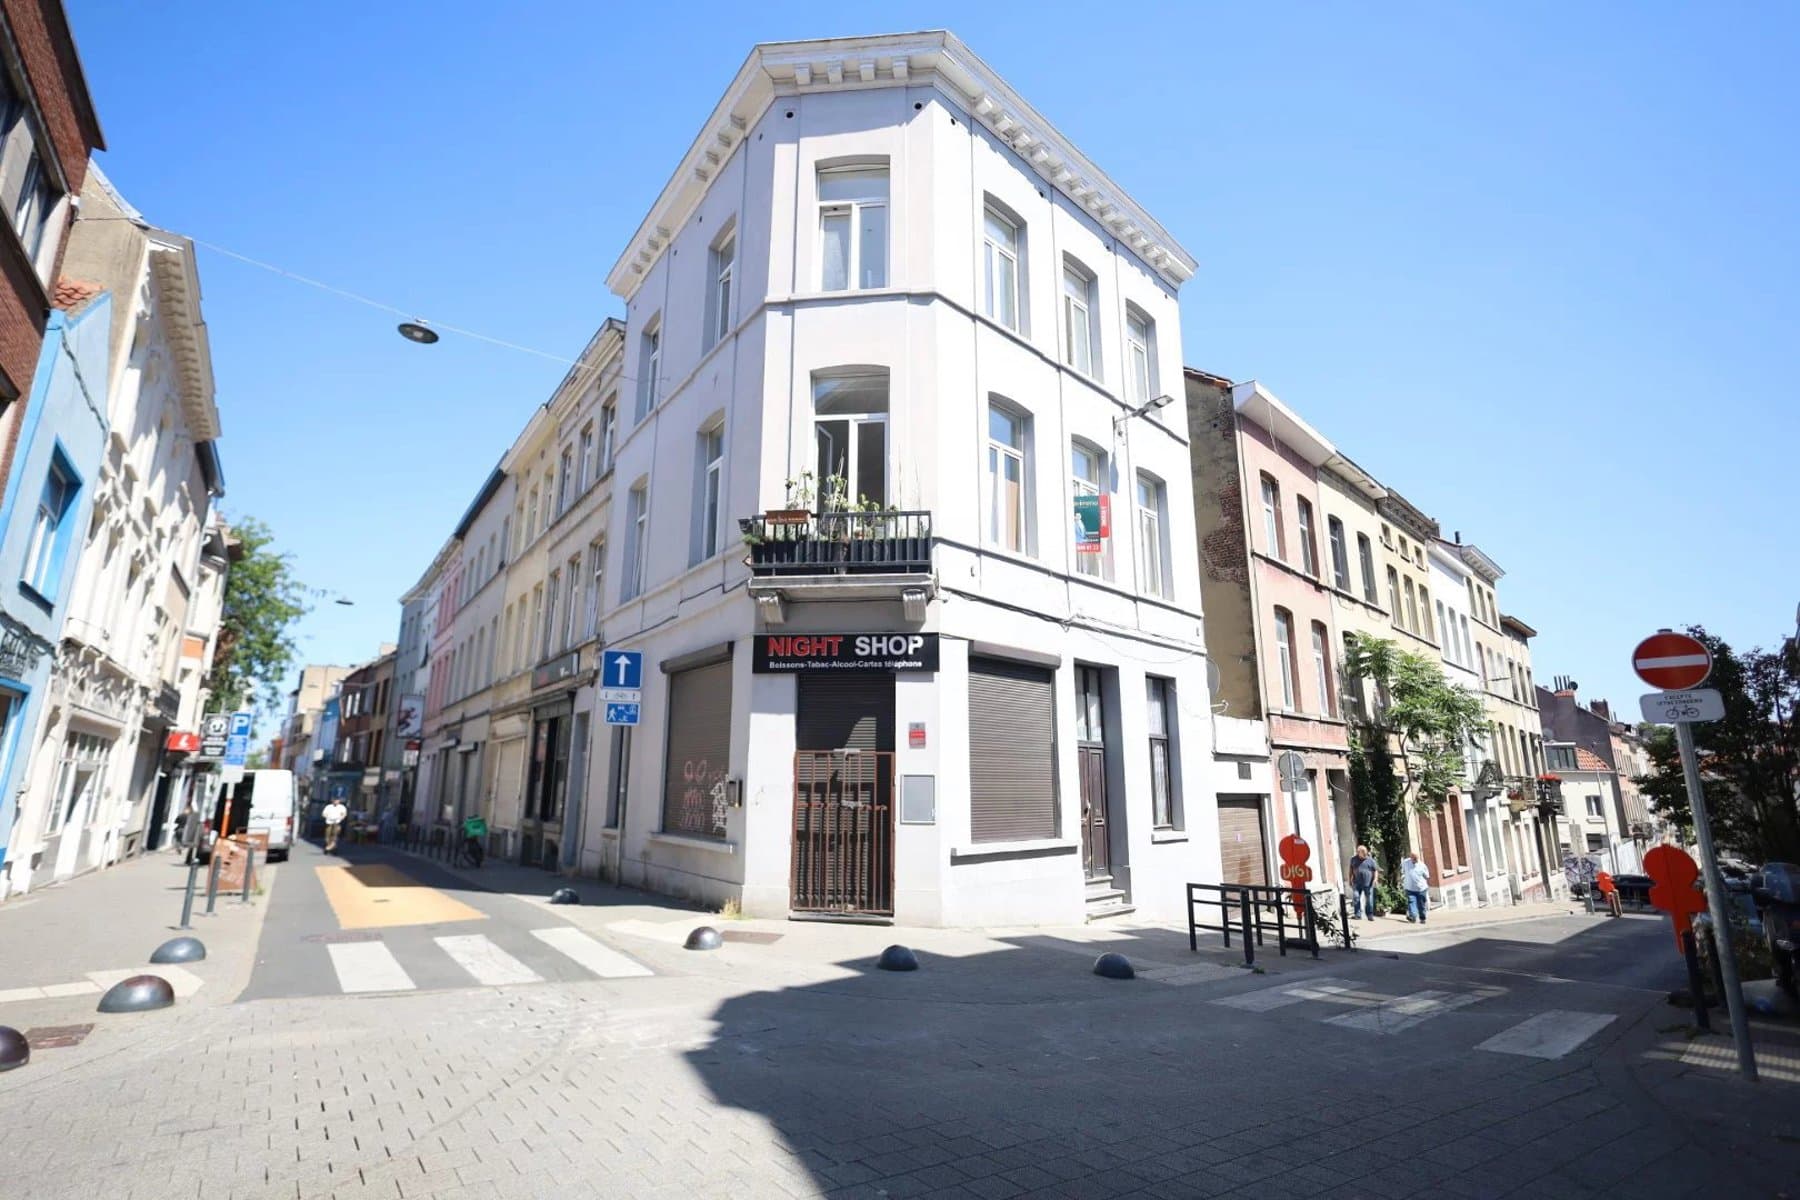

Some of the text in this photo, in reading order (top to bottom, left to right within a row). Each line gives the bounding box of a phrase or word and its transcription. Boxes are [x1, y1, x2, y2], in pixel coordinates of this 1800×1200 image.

[768, 636, 924, 656] NIGHT SHOP
[231, 715, 249, 734] P
